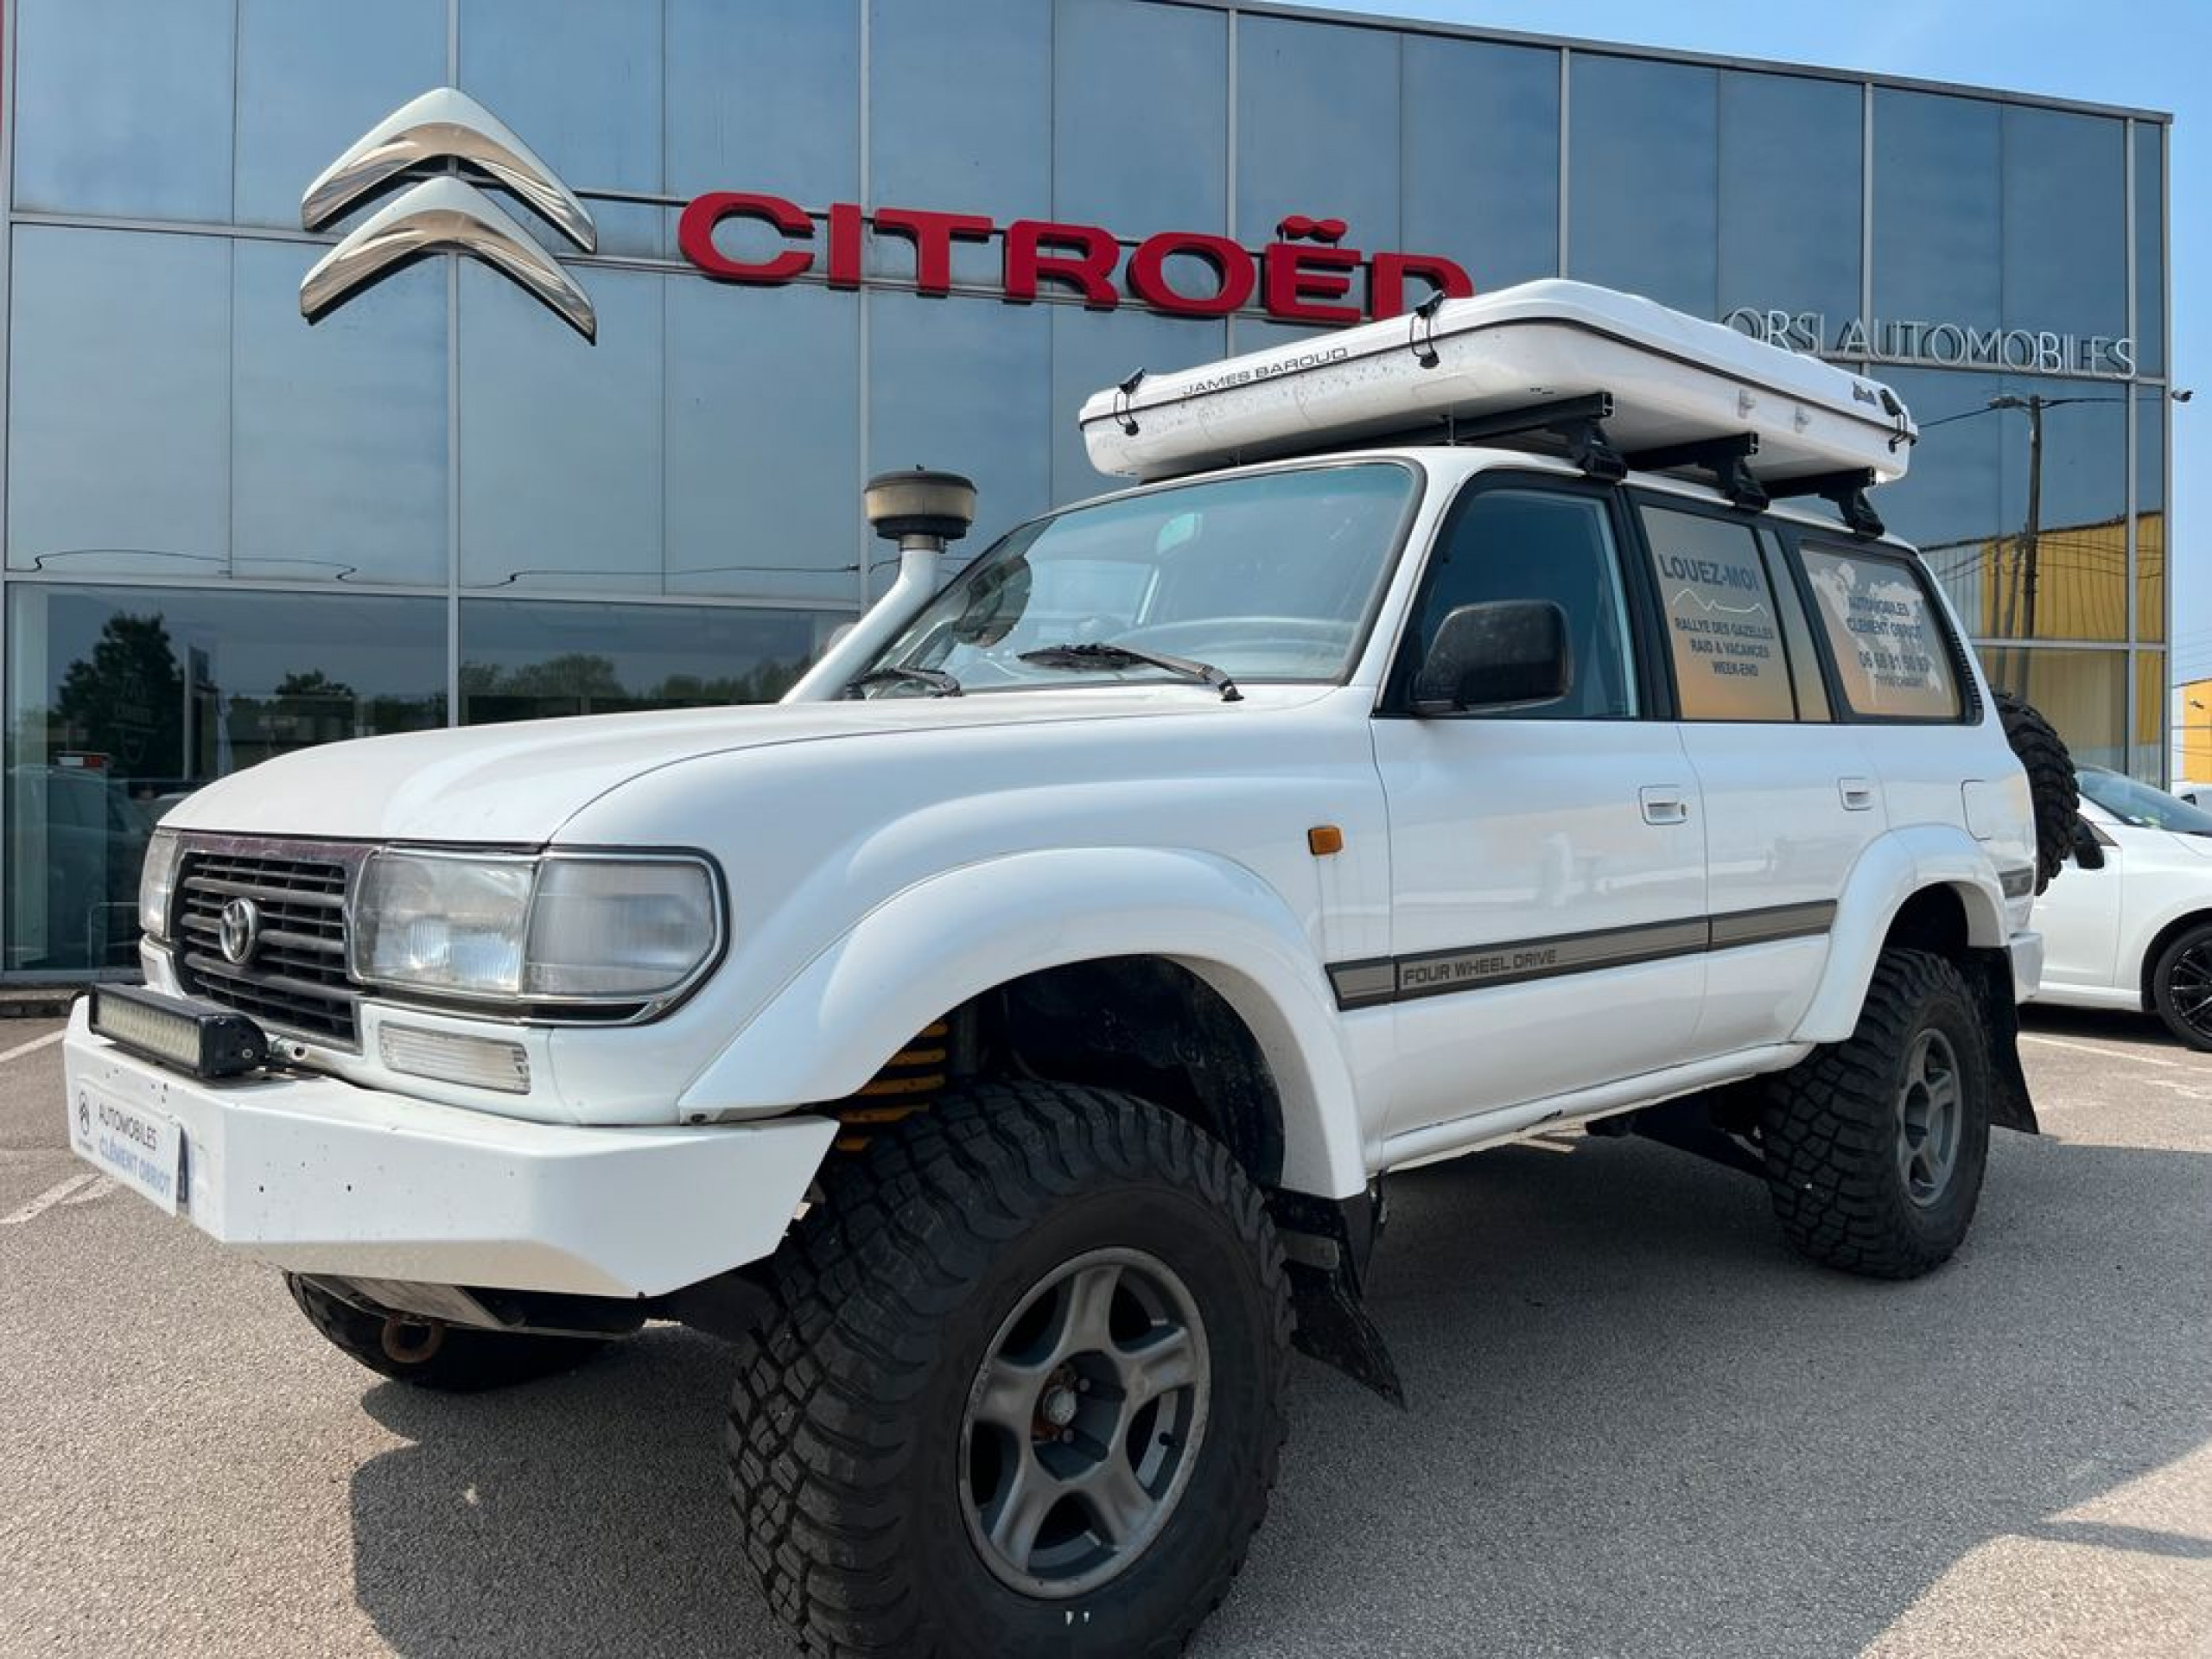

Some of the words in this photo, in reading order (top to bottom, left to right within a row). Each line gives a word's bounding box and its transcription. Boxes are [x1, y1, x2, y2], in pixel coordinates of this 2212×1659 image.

[1183, 372, 1251, 396] JAMES
[1255, 347, 1348, 379] BAROUD
[1844, 316, 2136, 378] AUTOMOBILES
[1403, 963, 1450, 986] FOUR
[1454, 955, 1510, 977] WHEEL
[1513, 949, 1556, 969] DRIVE
